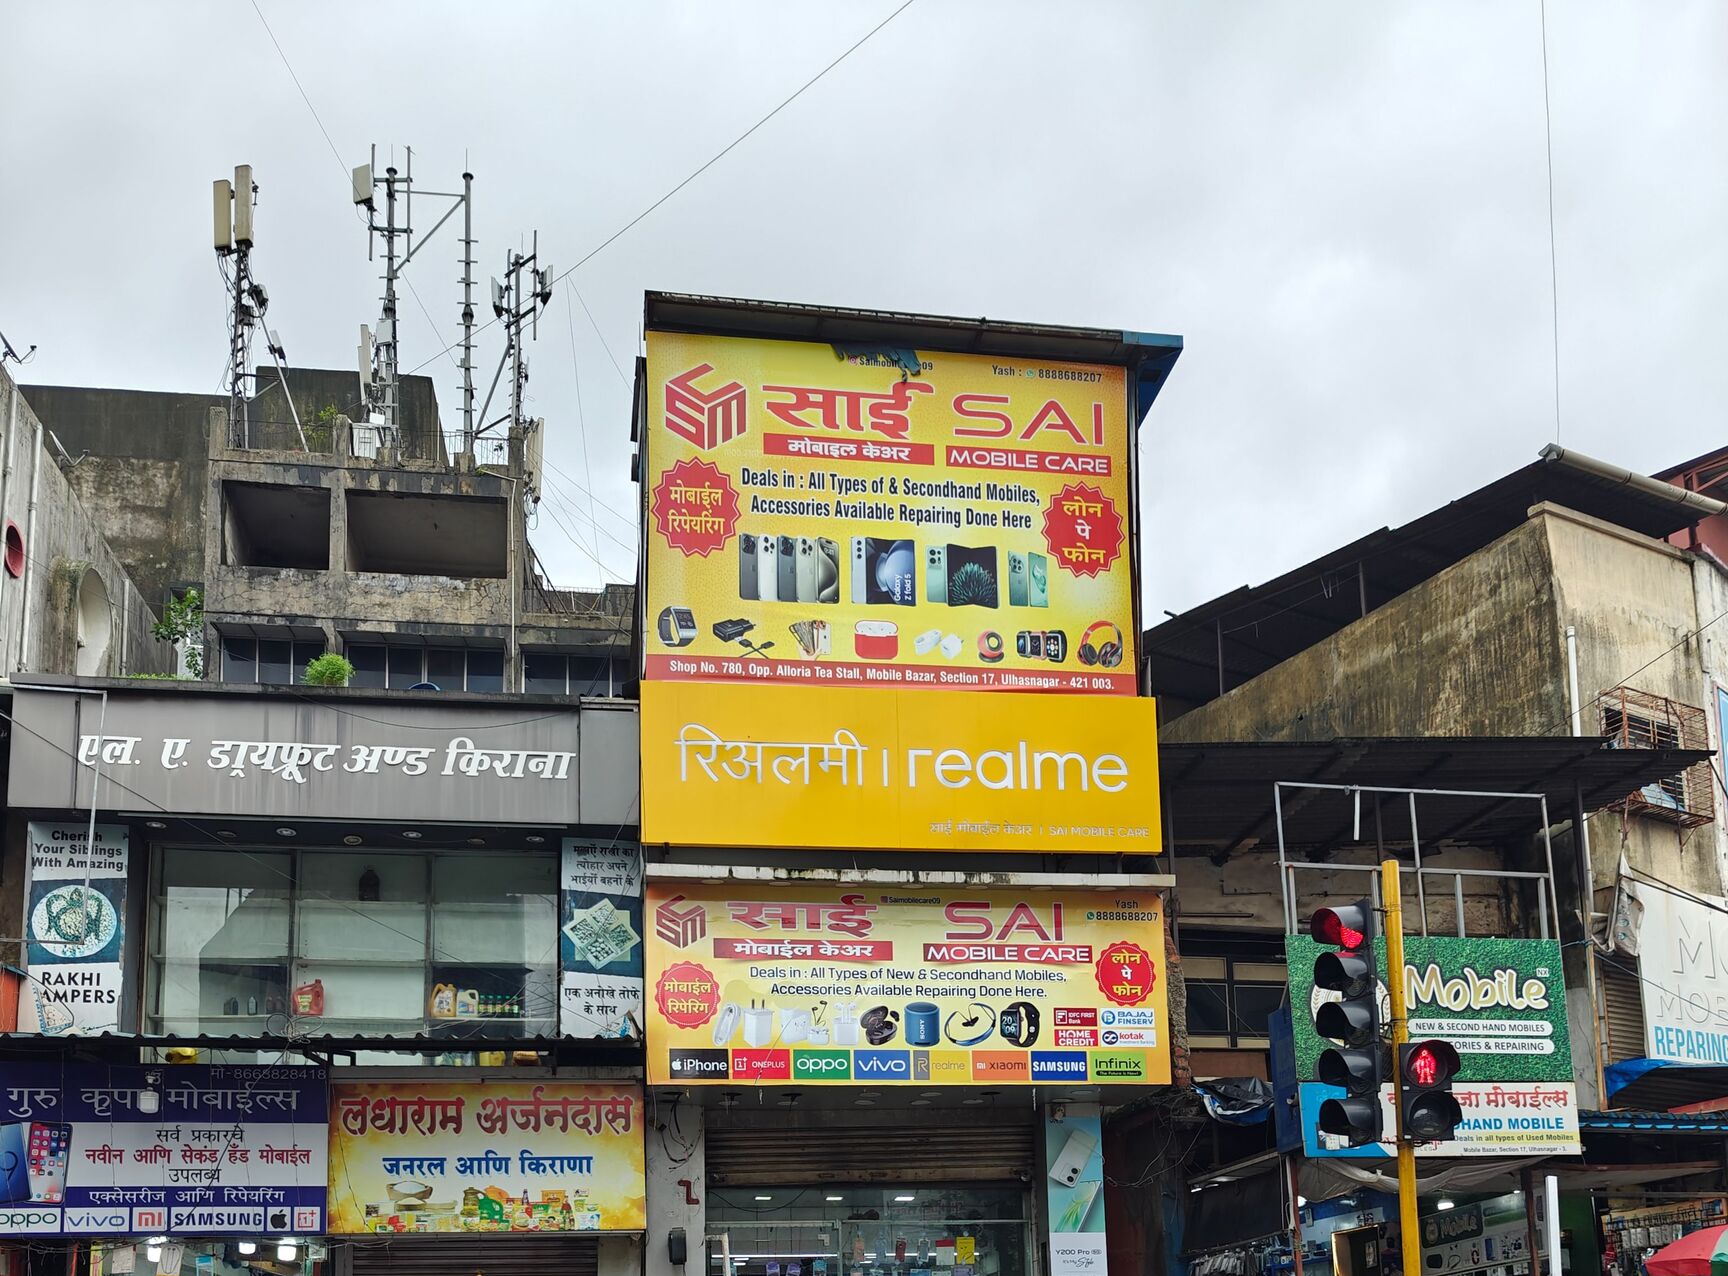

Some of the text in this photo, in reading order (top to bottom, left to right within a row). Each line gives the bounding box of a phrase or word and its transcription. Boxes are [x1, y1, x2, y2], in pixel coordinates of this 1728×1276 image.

[992, 365, 1102, 383] Yash 8888688207
[762, 382, 934, 440] साई
[953, 394, 1104, 446] SAI
[787, 438, 911, 461] मोबाइल केअर
[950, 449, 1108, 474] MOBILE CARE
[670, 480, 722, 509] मोबाईल
[742, 467, 1040, 506] Deals in All Types of & Secondhand Mobiles,
[751, 495, 1032, 528] Accessories Available Repairing Done Here
[1062, 495, 1103, 518] लोन
[667, 509, 725, 535] रिपेयरिंग
[1075, 518, 1091, 539] पे
[1062, 541, 1106, 564] फोन
[670, 660, 697, 675] Shop
[700, 662, 718, 674] No.
[721, 663, 746, 676] 780,
[749, 663, 772, 679] Opp.
[776, 663, 811, 679] Alloria
[814, 666, 833, 679] Tea
[837, 666, 862, 682] Stall,
[866, 667, 899, 682] Mobile
[903, 669, 936, 684] Bazar,
[940, 670, 976, 685] Section
[980, 673, 998, 687] 17,
[1001, 673, 1059, 690] Ulhasnagar
[1070, 676, 1088, 688] 421
[1092, 676, 1115, 690] 003.
[343, 744, 436, 776] अण्ड
[440, 737, 575, 780] किराना
[673, 723, 868, 785] रिअलमी
[909, 741, 1128, 792] realme
[1049, 827, 1148, 837] SAI MOBILE CARE
[32, 857, 123, 871] With Amazing
[1115, 899, 1139, 910] Yash
[726, 894, 880, 940] साई
[945, 902, 1064, 942] SAI
[1096, 910, 1158, 921] 8888688207
[734, 937, 873, 960] मोबाईल केअर
[927, 946, 1089, 962] MOBILE CARE
[42, 972, 101, 986] RAKHI
[1404, 964, 1549, 1011] Mobile
[565, 988, 581, 1001] एक
[585, 986, 615, 998] अनोखे
[584, 1003, 617, 1015] के साथ
[1119, 1032, 1144, 1040] kotak
[1415, 1022, 1435, 1030] NEW
[1446, 1022, 1480, 1031] SECOND
[1482, 1023, 1506, 1031] HAND
[1508, 1024, 1544, 1032] MOBILES
[684, 1059, 727, 1070] iPhone
[797, 1058, 848, 1072] oppo
[858, 1057, 906, 1072] vivo
[932, 1061, 965, 1070] realme
[990, 1061, 1026, 1070] xiaomi
[1033, 1062, 1085, 1071] SAMSUNG
[1095, 1058, 1141, 1069] Infinix
[6, 1087, 60, 1118] गुरु
[166, 1081, 301, 1113] मोबाईल्स
[341, 1086, 633, 1136] लधाराम अर्जनदास
[156, 1124, 181, 1143] सर्व
[1509, 1118, 1564, 1130] MOBILE
[85, 1145, 125, 1164] नवीन
[133, 1144, 172, 1164] आणि
[181, 1144, 219, 1164] सेकंड
[259, 1143, 312, 1166] मोबाईल
[382, 1150, 593, 1176] जनरल आणि किराणा
[168, 1168, 221, 1184] उपलब्ध
[176, 1189, 215, 1204] आणि
[224, 1189, 285, 1203] रिपेयरिंग
[68, 1213, 125, 1226] vivo
[175, 1213, 262, 1226] SAMSUNG
